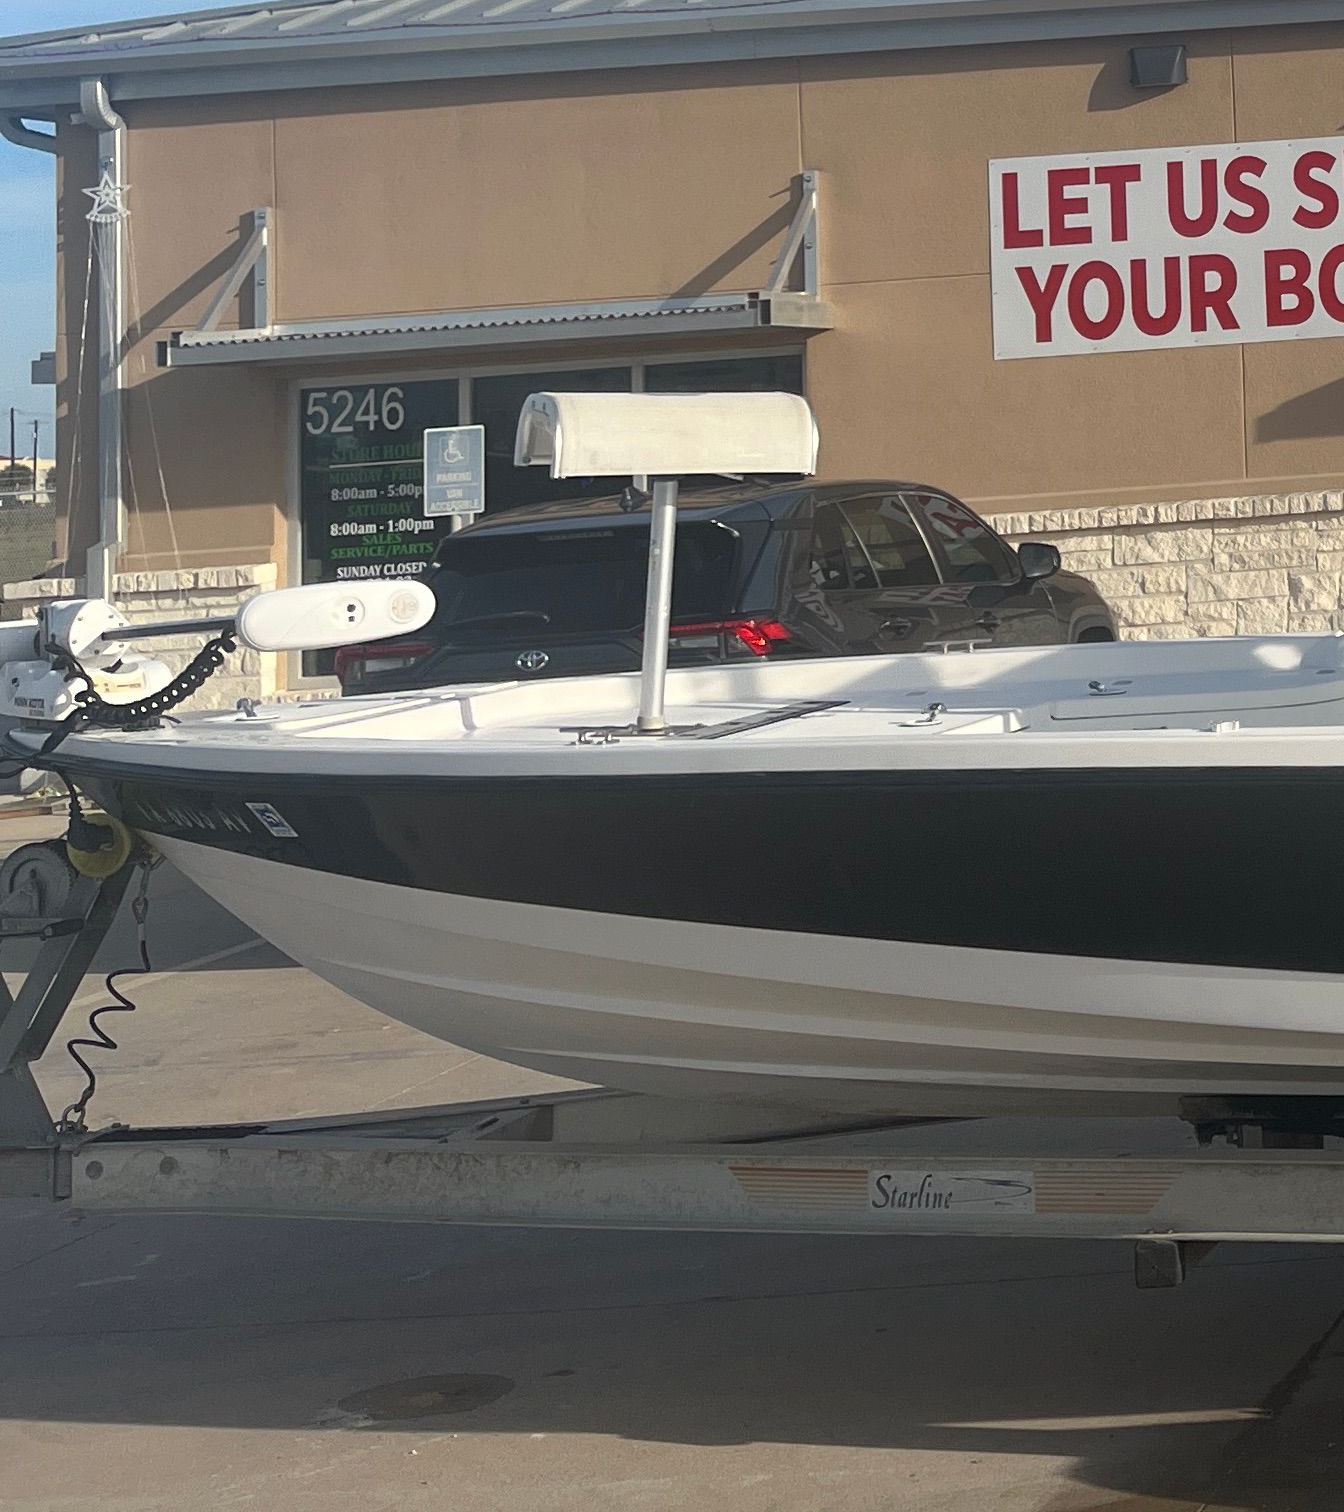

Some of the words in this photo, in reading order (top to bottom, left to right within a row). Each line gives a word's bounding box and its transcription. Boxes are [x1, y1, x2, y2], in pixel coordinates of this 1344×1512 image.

[1002, 164, 1142, 250] LET
[1166, 155, 1270, 238] US
[1015, 253, 1241, 344] YOUR
[305, 387, 405, 435] 5246
[382, 441, 424, 459] HOU
[391, 464, 424, 481] FRID
[331, 485, 377, 501] 8:00am
[387, 484, 424, 500] 5:00p
[347, 501, 414, 517] SATURDAY
[330, 520, 377, 536] 8:00am
[387, 518, 434, 536] 1:00pm
[362, 533, 402, 545] SALES
[330, 542, 434, 559] SERVICE/PARTS
[337, 563, 383, 579] SUNDAY
[871, 1173, 953, 1210] Starline
